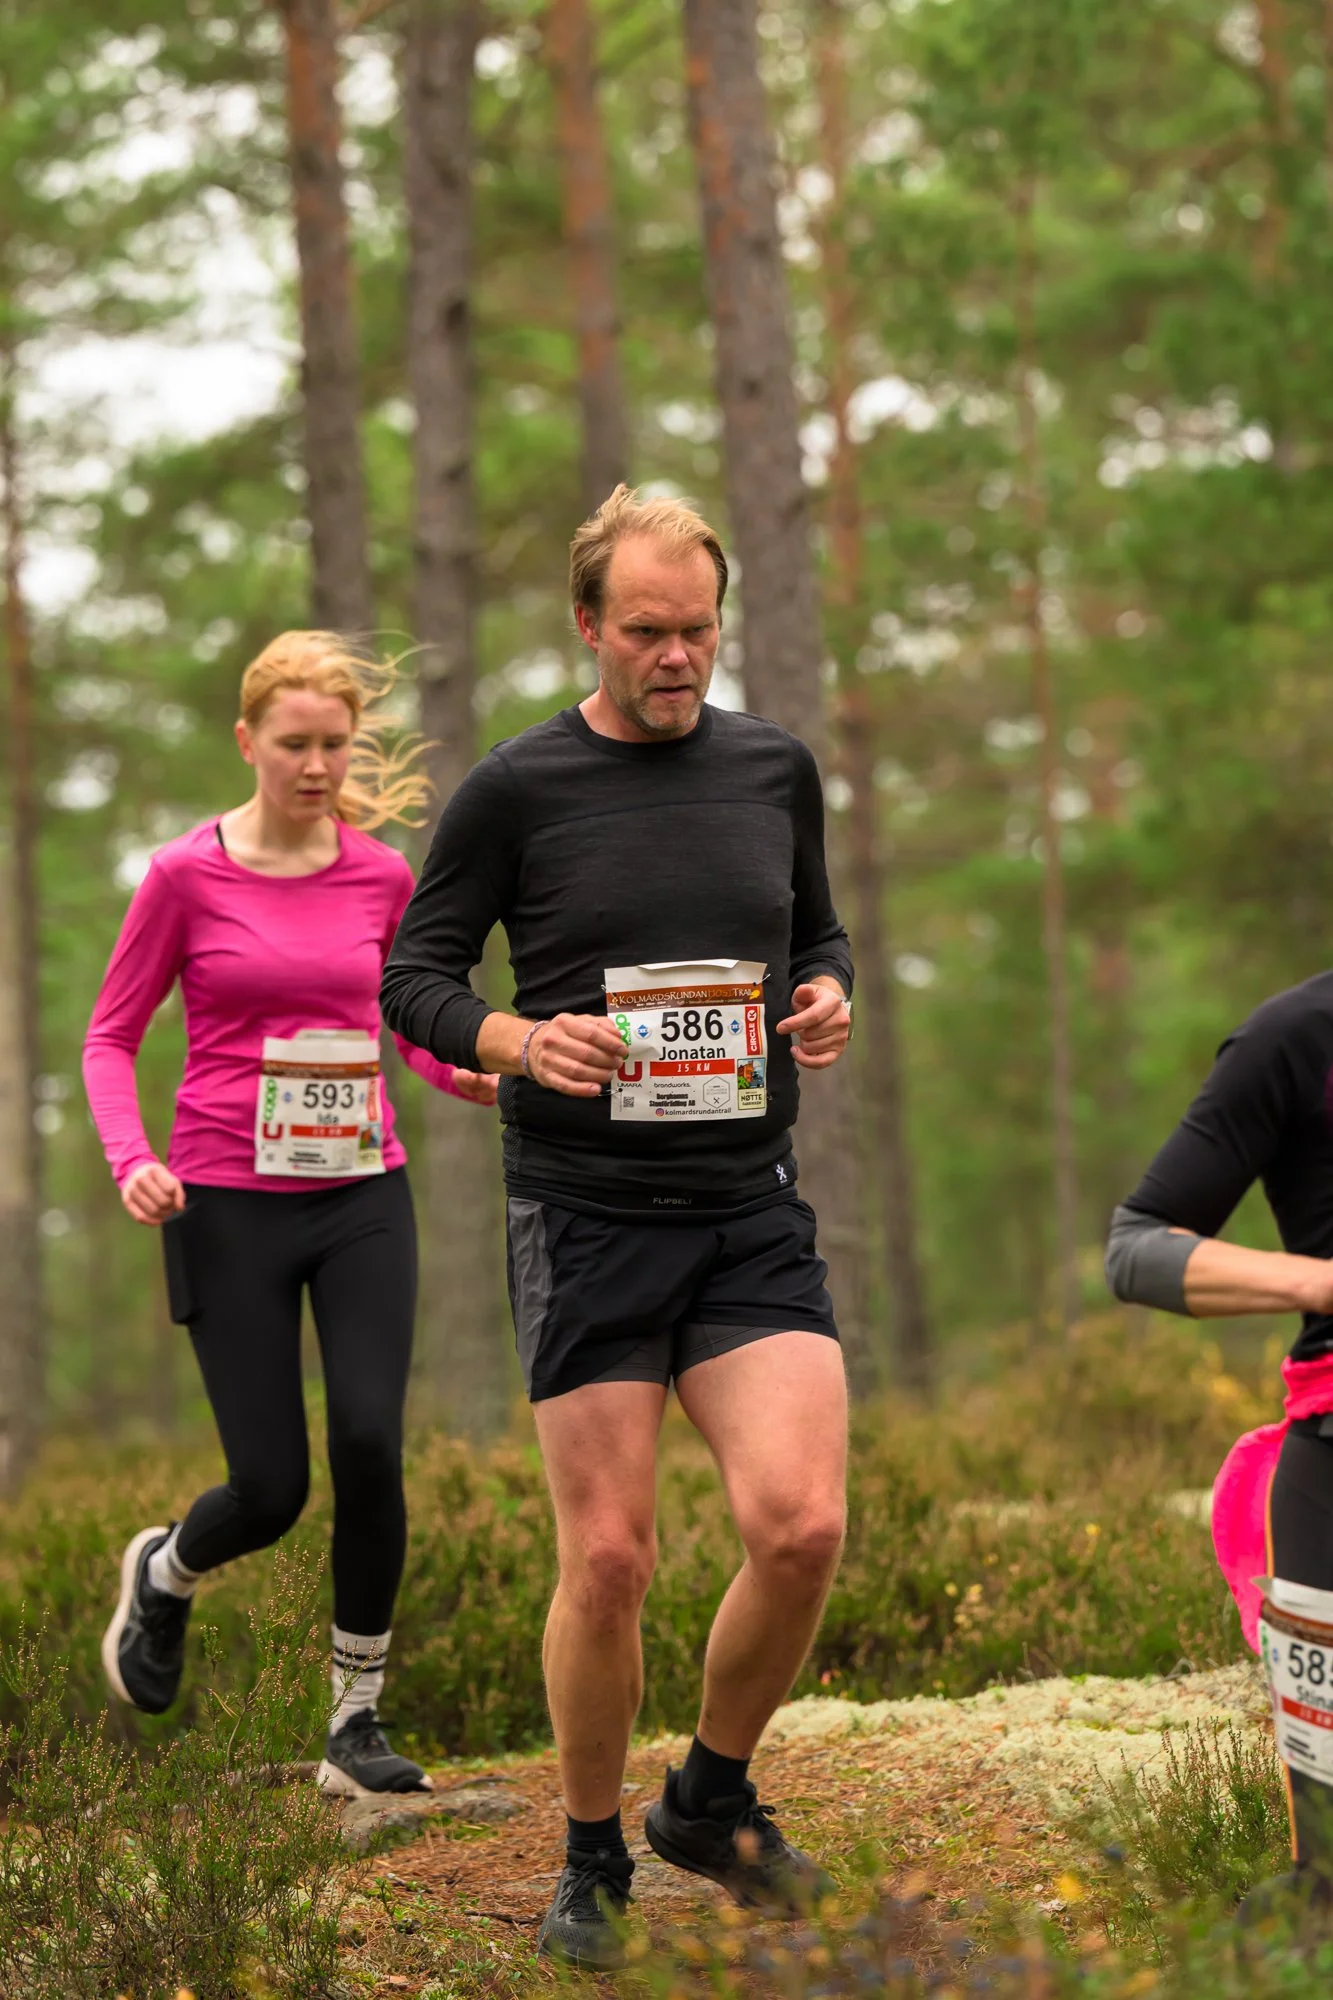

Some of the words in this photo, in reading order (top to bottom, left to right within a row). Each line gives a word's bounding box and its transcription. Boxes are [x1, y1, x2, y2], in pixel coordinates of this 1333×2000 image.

[660, 1009, 724, 1042] 586
[748, 1023, 757, 1052] CIRCLE
[658, 1045, 726, 1061] Jonatan
[677, 1063, 690, 1072] 15
[696, 1062, 711, 1072] KM
[302, 1083, 354, 1109] 593
[665, 1108, 731, 1116] kolmardsrundantrail
[1288, 1642, 1333, 1687] 58
